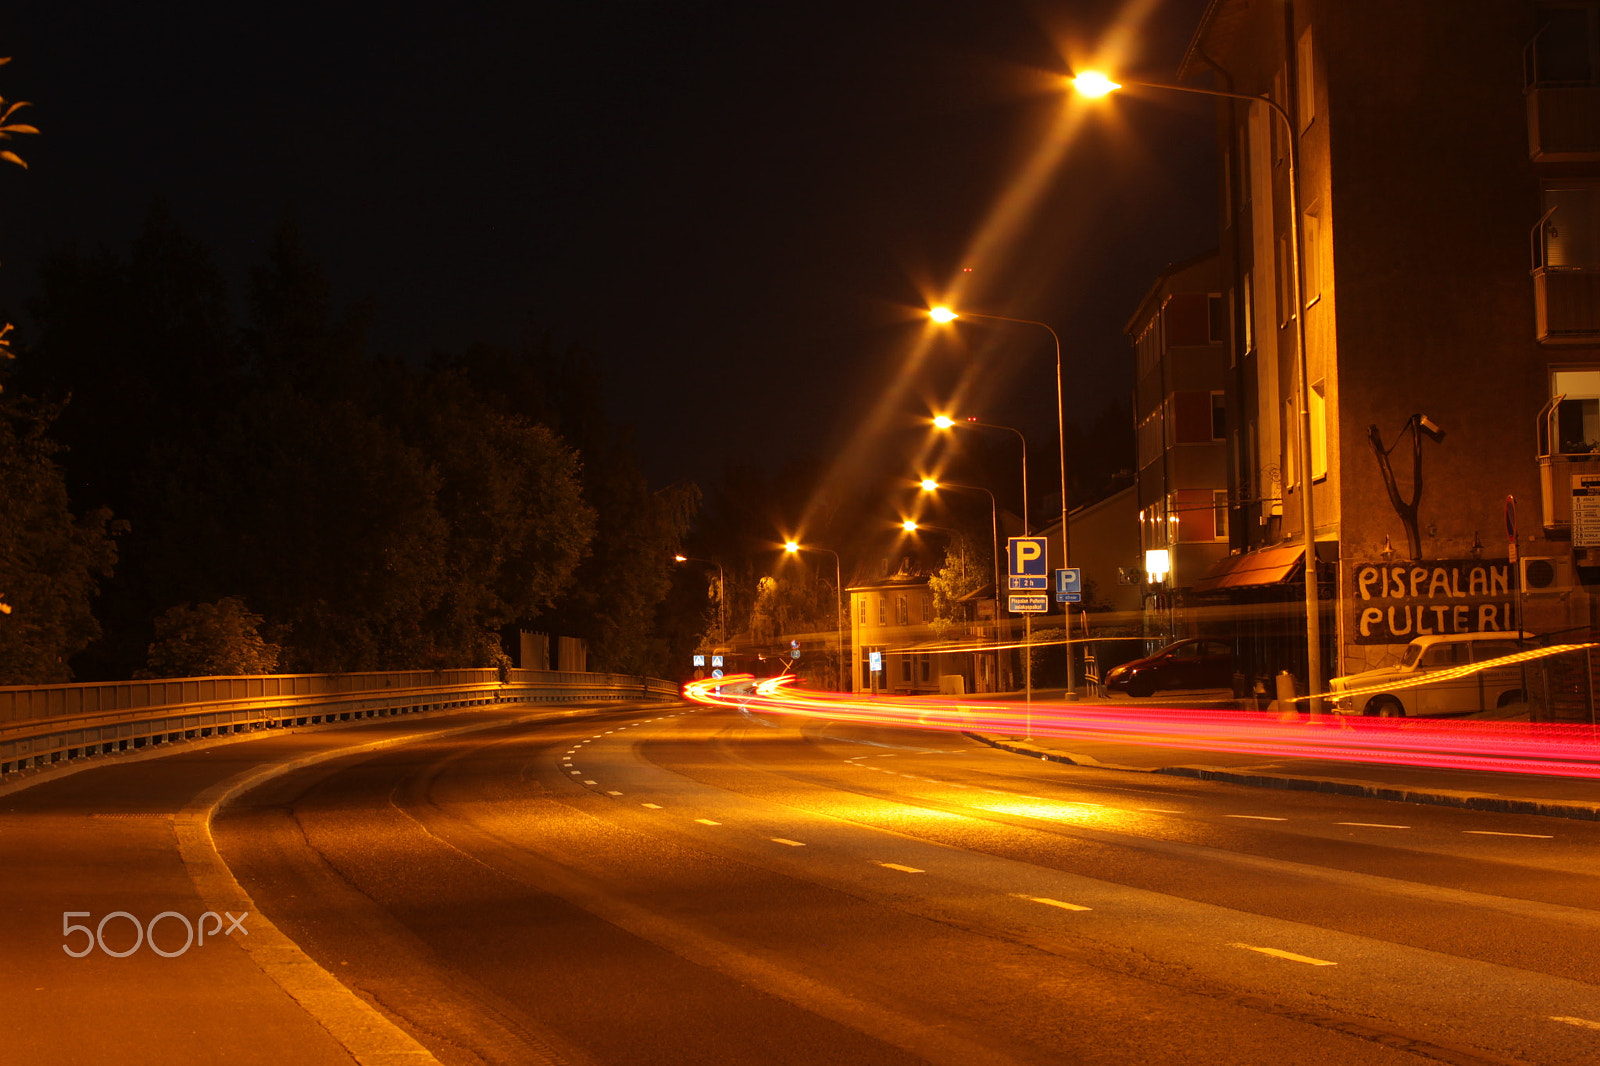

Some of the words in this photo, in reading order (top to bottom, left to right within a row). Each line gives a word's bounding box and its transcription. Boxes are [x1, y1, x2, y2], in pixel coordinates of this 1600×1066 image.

[1016, 541, 1042, 573] P
[1061, 571, 1077, 591] P
[1359, 566, 1509, 600] PISPALAN
[1360, 602, 1510, 636] PULTERI
